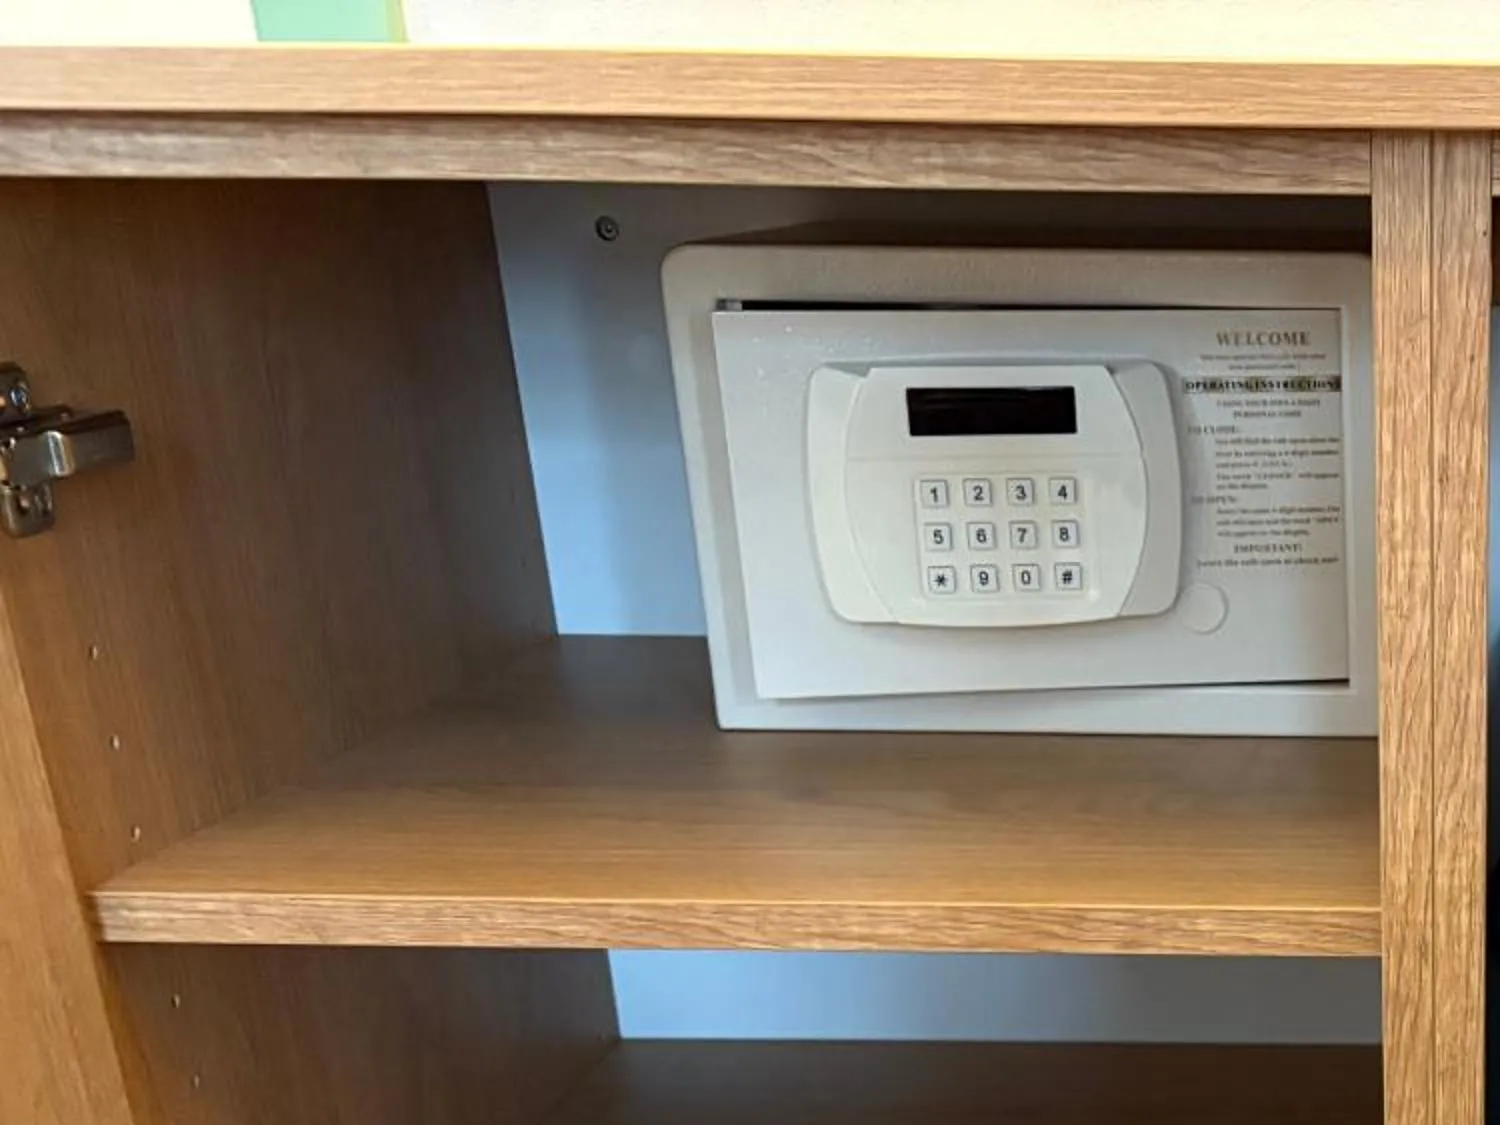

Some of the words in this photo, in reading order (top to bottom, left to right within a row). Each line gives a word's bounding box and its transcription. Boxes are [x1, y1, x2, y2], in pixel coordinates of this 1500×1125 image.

[1216, 331, 1311, 346] WELCOME
[1185, 379, 1252, 391] OPERATING
[930, 487, 939, 502] 1
[973, 485, 984, 500] 2
[1015, 485, 1027, 500] 3
[1057, 485, 1068, 500] 4
[933, 529, 944, 544] 5
[976, 528, 987, 543] 6
[1017, 528, 1028, 542] 7
[1059, 527, 1069, 542] 8
[979, 571, 989, 586] 9
[1021, 570, 1031, 585] 0
